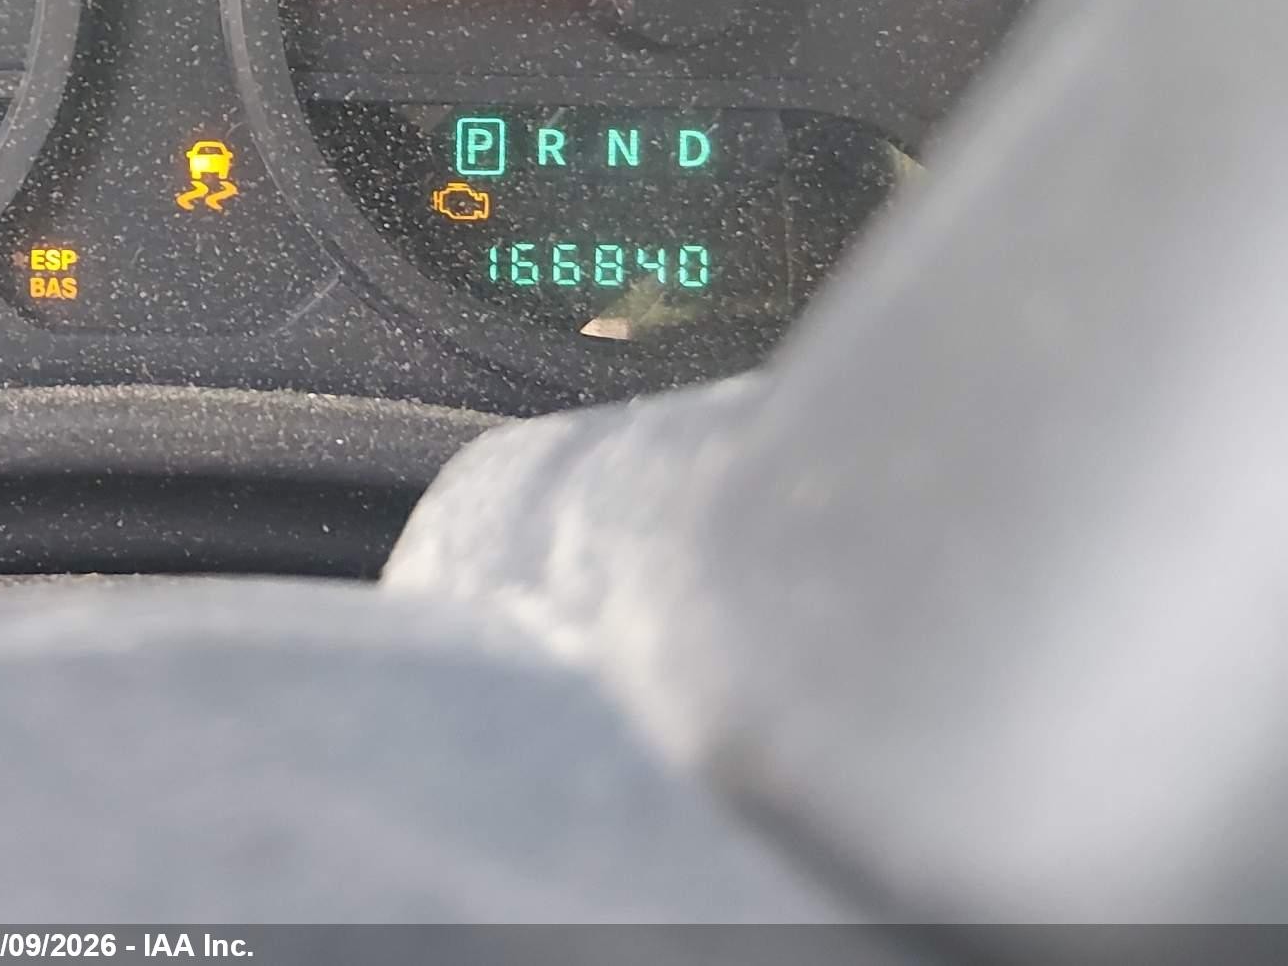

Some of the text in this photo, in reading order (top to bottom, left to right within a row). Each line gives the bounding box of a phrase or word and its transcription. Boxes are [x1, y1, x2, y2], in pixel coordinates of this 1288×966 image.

[467, 128, 710, 166] P R N D
[31, 249, 76, 270] ESP
[487, 243, 708, 287] 166840
[30, 277, 77, 299] BAS
